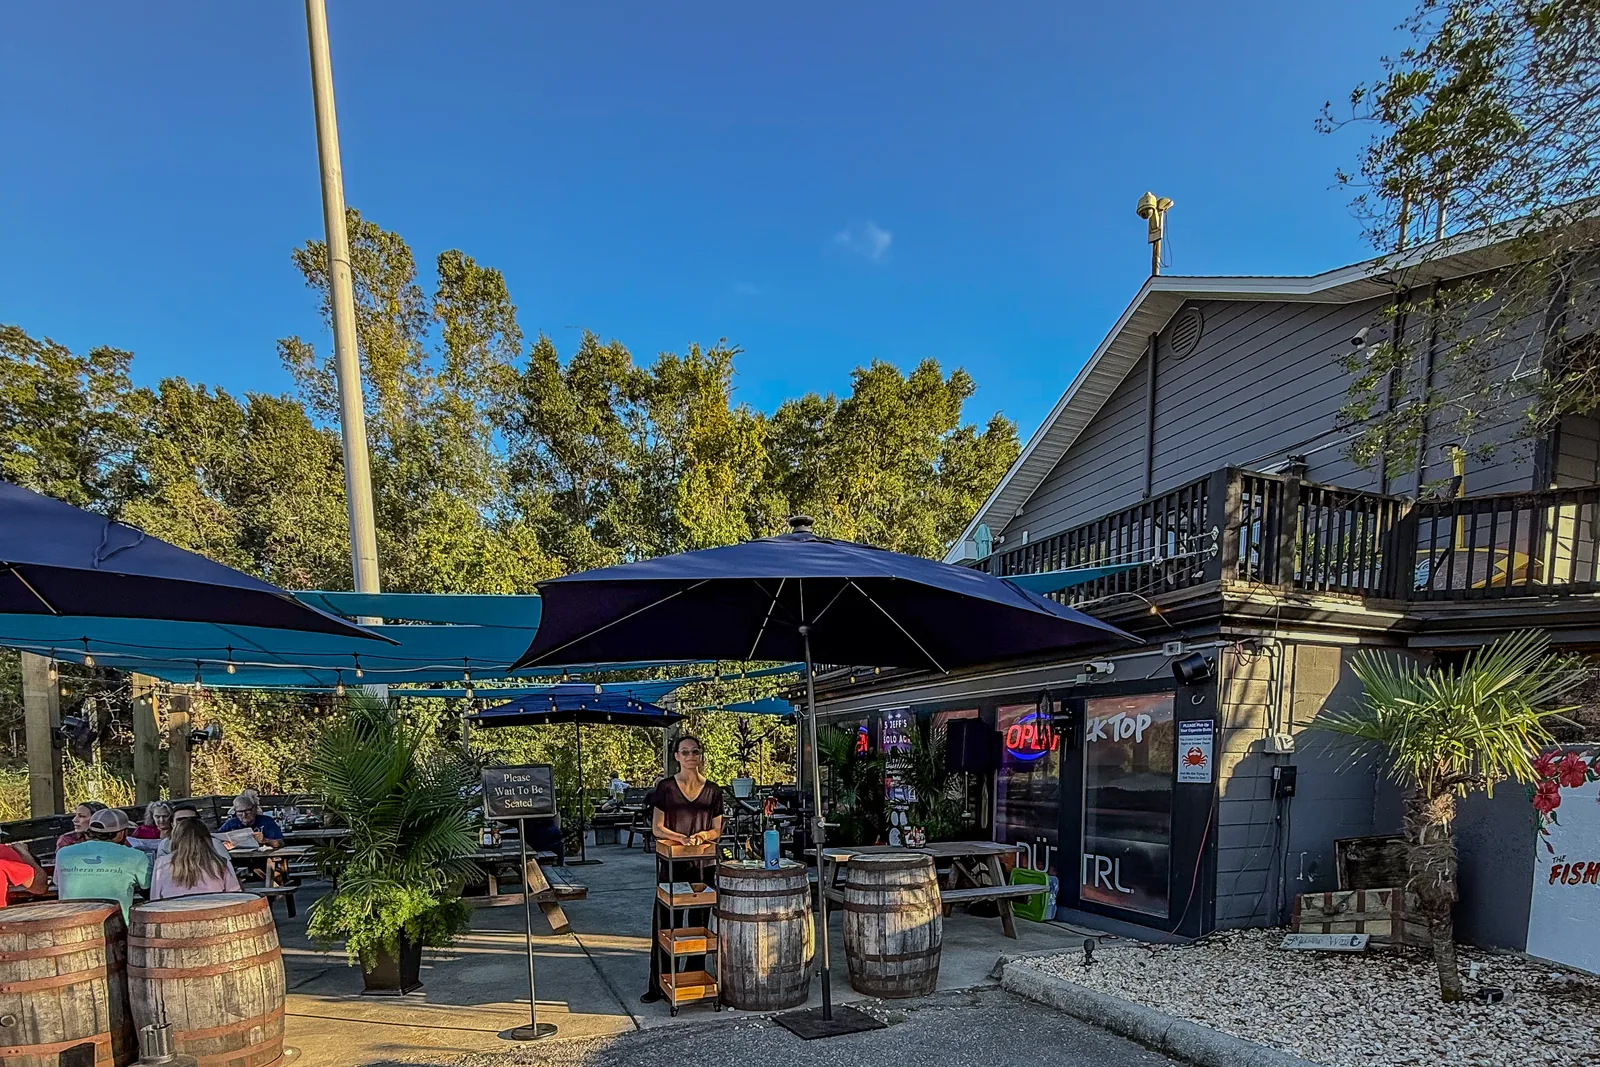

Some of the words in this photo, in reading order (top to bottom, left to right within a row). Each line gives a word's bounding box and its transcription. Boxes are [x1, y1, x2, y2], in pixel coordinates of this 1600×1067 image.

[503, 773, 531, 783] Please
[494, 786, 515, 796] Wait
[517, 785, 529, 795] To
[531, 785, 543, 794] Be
[504, 798, 533, 809] Seated
[1552, 854, 1566, 864] THE
[60, 865, 93, 873] southern
[1548, 861, 1600, 886] FISH
